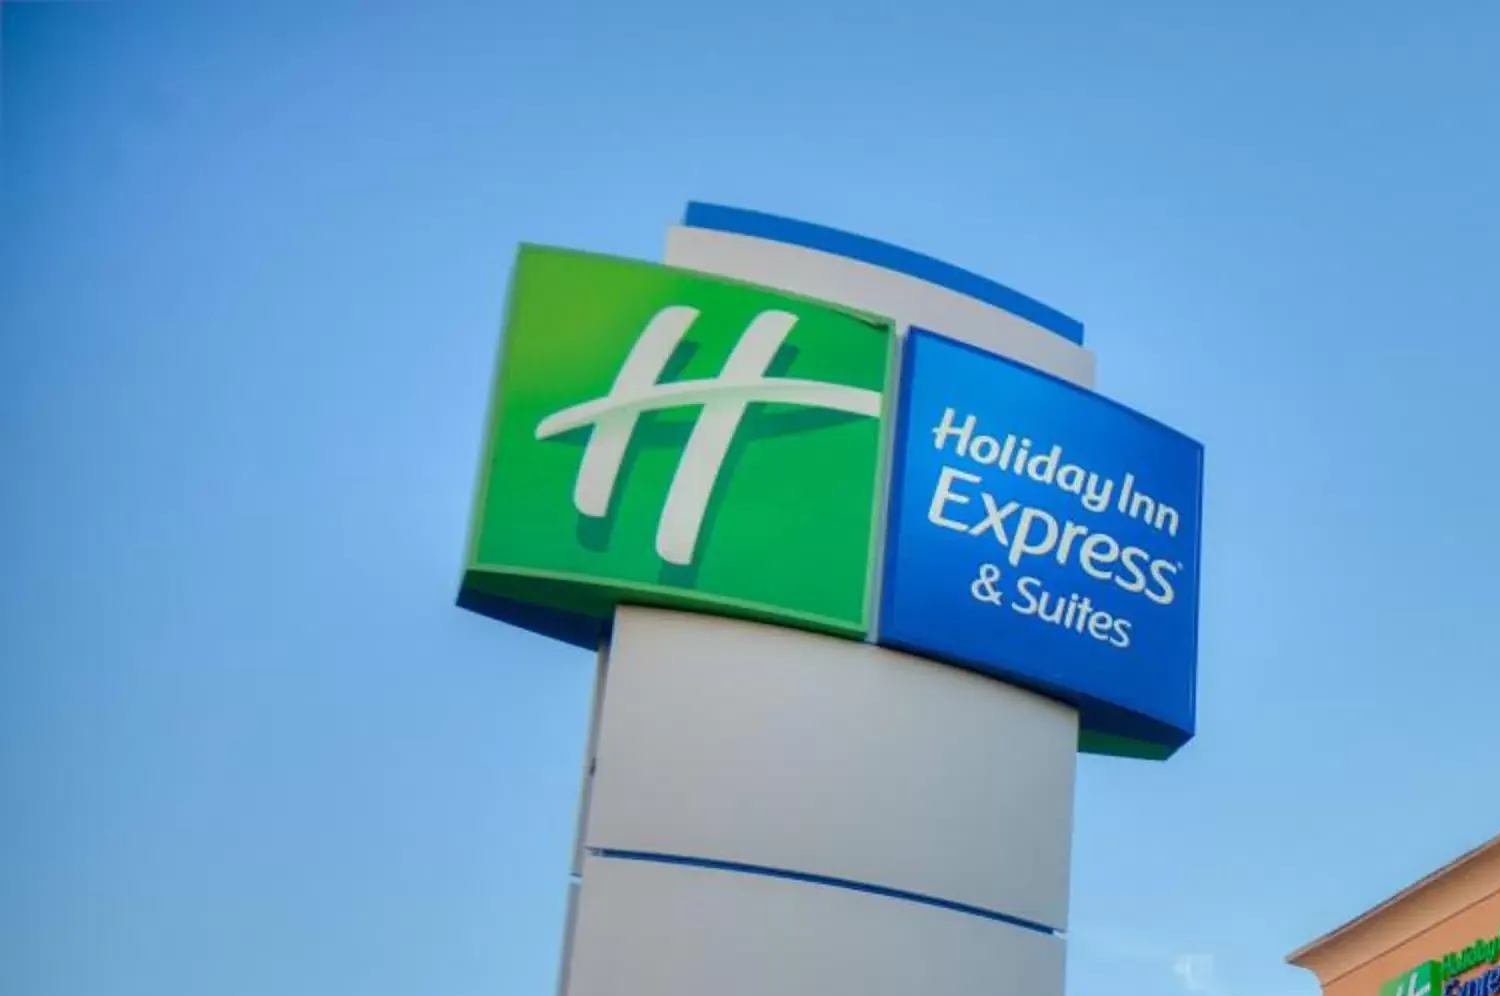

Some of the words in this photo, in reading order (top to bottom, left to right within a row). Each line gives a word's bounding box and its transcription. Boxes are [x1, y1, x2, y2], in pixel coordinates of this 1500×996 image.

[927, 465, 1177, 606] Express
[932, 407, 1114, 512] Holiday
[1118, 473, 1180, 538] Inn
[971, 563, 1003, 606] &
[1011, 575, 1132, 648] Suites
